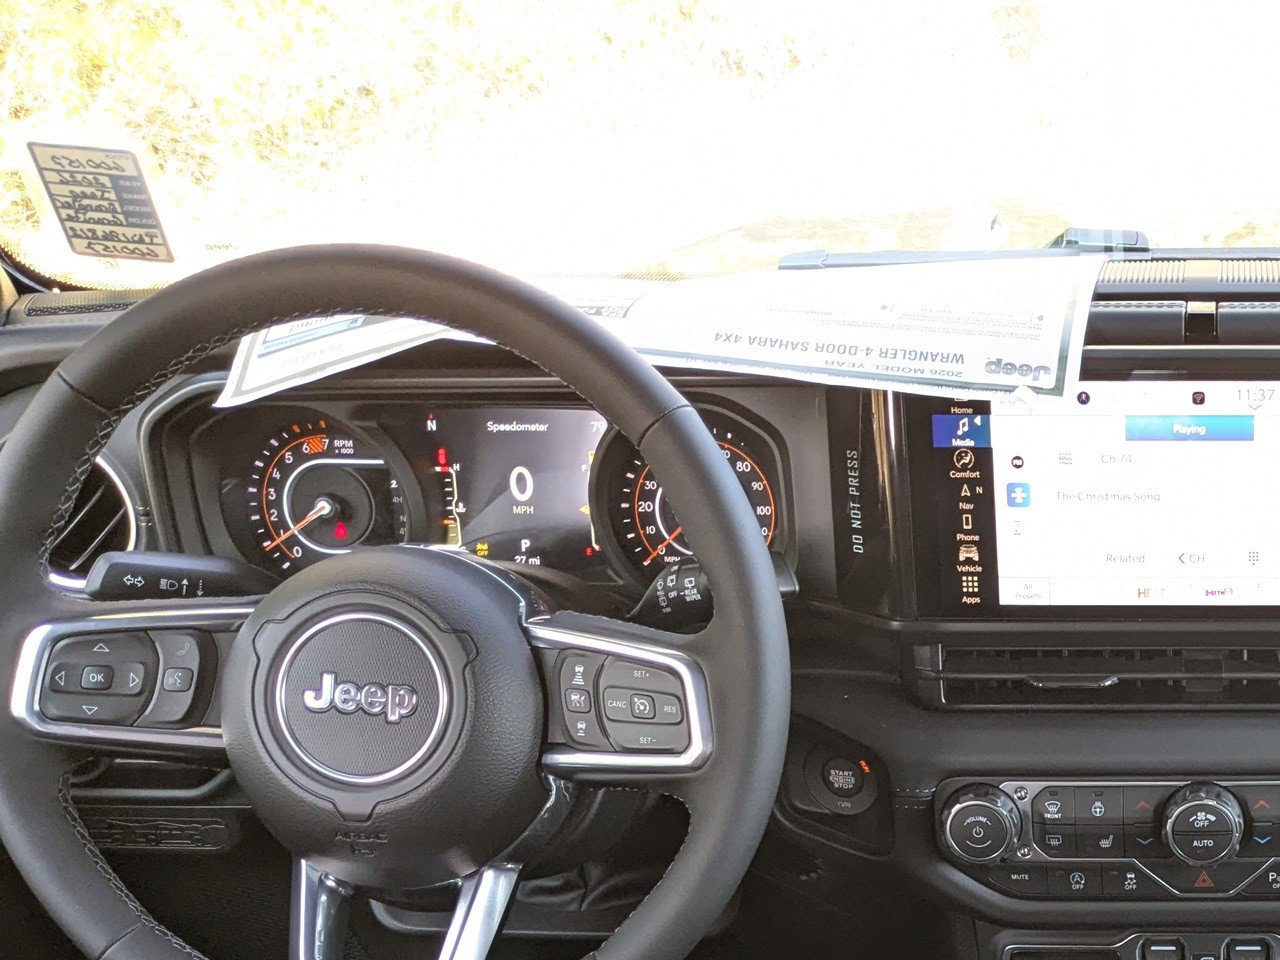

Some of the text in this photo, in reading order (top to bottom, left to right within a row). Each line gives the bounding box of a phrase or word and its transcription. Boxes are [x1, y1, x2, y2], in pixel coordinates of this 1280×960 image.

[714, 331, 965, 365] WRANGLER 4-DOOR SAHARA 4X4
[824, 359, 963, 378] 2026 MODEL YEAR
[985, 356, 1052, 381] Jeep
[1236, 388, 1275, 402] 11:37
[427, 420, 437, 431] N
[486, 421, 549, 433] Speedometer
[1171, 423, 1207, 436] Playing
[333, 439, 354, 448] RPM
[952, 438, 975, 447] Media
[284, 451, 294, 464] 5
[736, 461, 751, 472] 80
[272, 468, 281, 480] 4
[950, 470, 981, 478] Comfort
[509, 466, 534, 502] 0
[644, 480, 657, 490] 30
[751, 482, 763, 491] 90
[268, 488, 276, 500] 3
[976, 486, 983, 494] N
[638, 501, 653, 512] 20
[846, 450, 864, 554] DO NOT PRESS
[512, 505, 534, 514] MPH
[756, 506, 772, 516] 100
[270, 510, 279, 521] 2
[645, 525, 656, 535] 10
[956, 533, 980, 541] Phone
[520, 539, 531, 552] P
[293, 546, 302, 557] 0
[1105, 553, 1146, 564] Related
[956, 564, 982, 572] Vehicle
[962, 596, 981, 605] Apps
[89, 672, 105, 682] OK
[303, 671, 418, 723] Jeep
[607, 699, 627, 708] CANC
[663, 705, 677, 713] RES
[965, 815, 988, 824] VOLUME
[1193, 839, 1214, 847] AUTO
